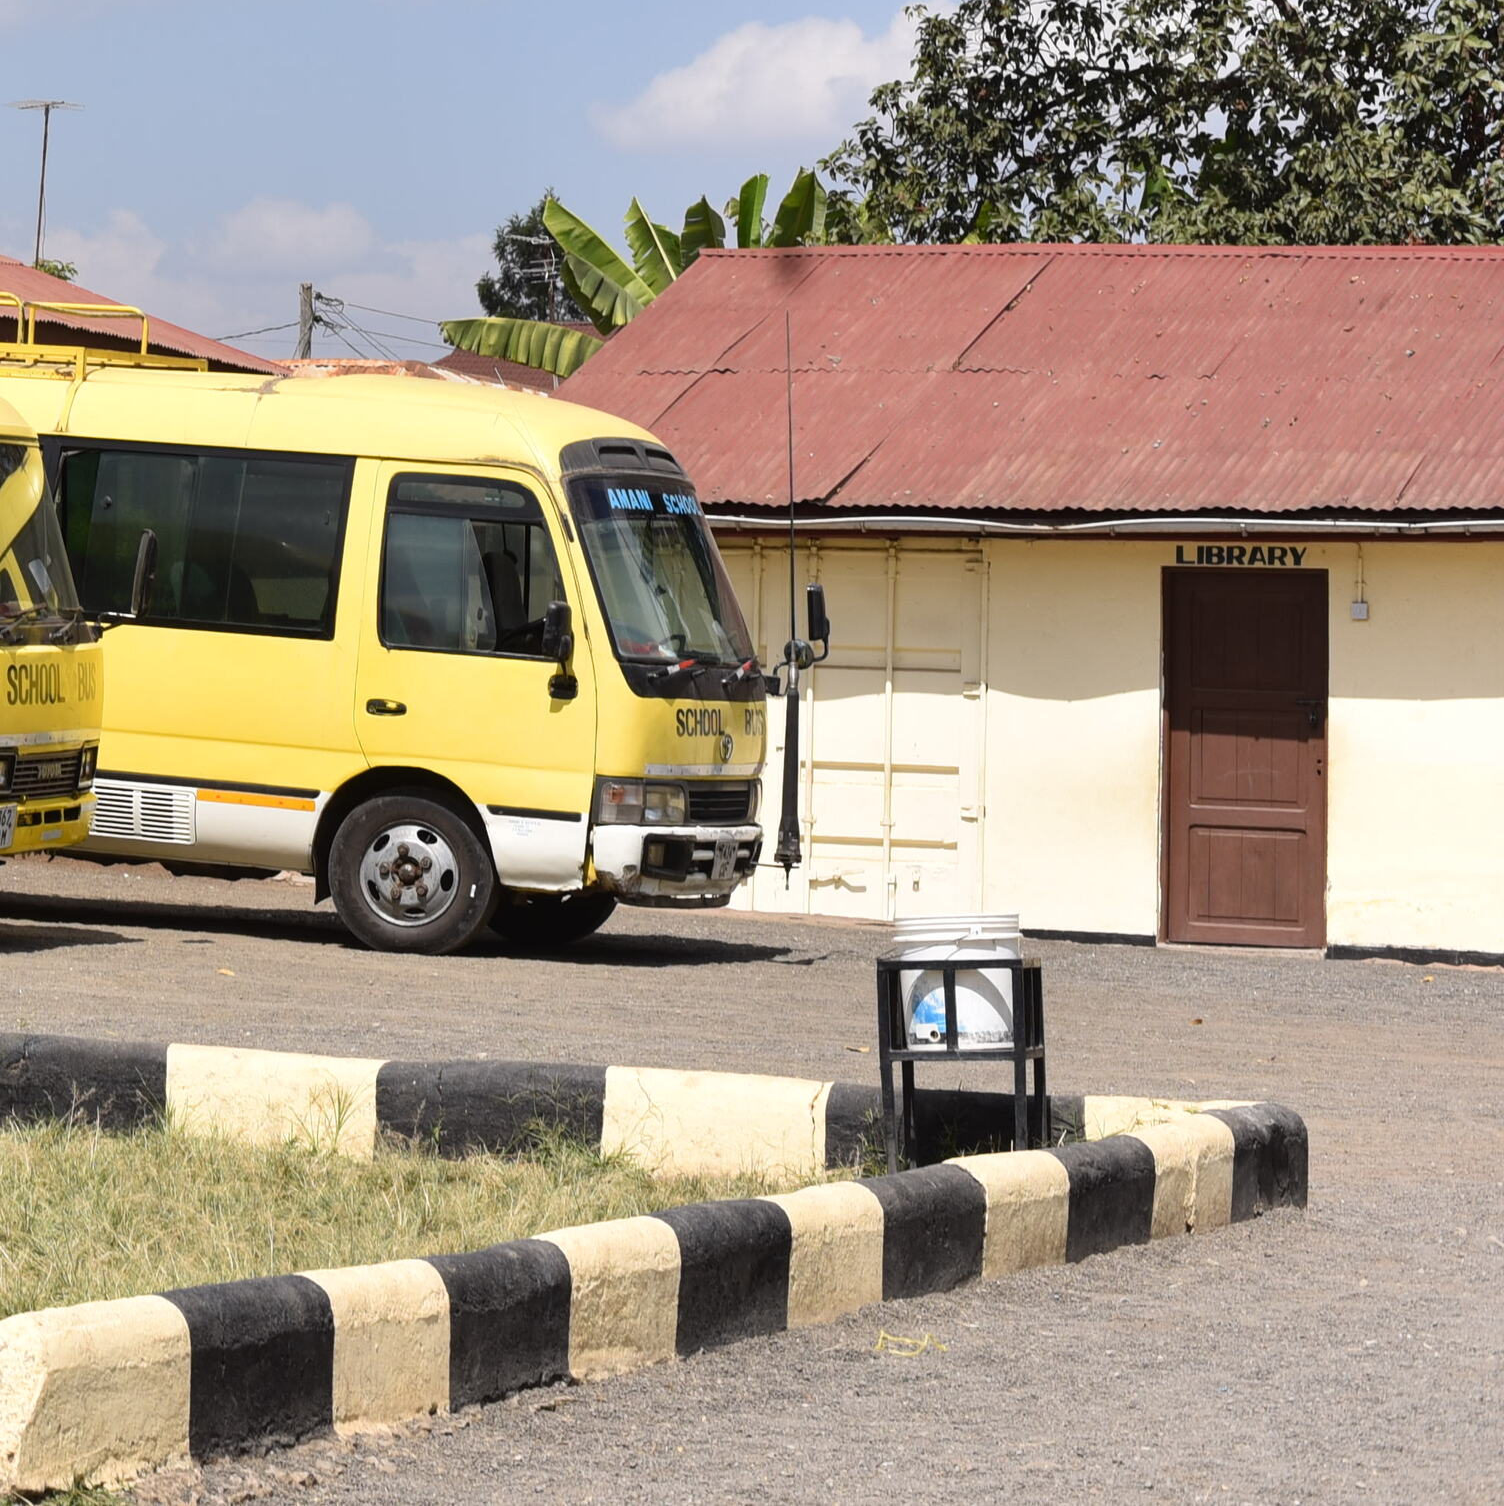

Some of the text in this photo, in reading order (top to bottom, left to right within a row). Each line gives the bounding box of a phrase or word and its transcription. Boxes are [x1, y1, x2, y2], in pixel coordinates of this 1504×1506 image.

[607, 487, 703, 516] AMANI SCHOOL
[1175, 545, 1307, 567] LIBRARY
[7, 662, 97, 705] SCHOOL BUS
[675, 708, 765, 737] SCHOOL BUS
